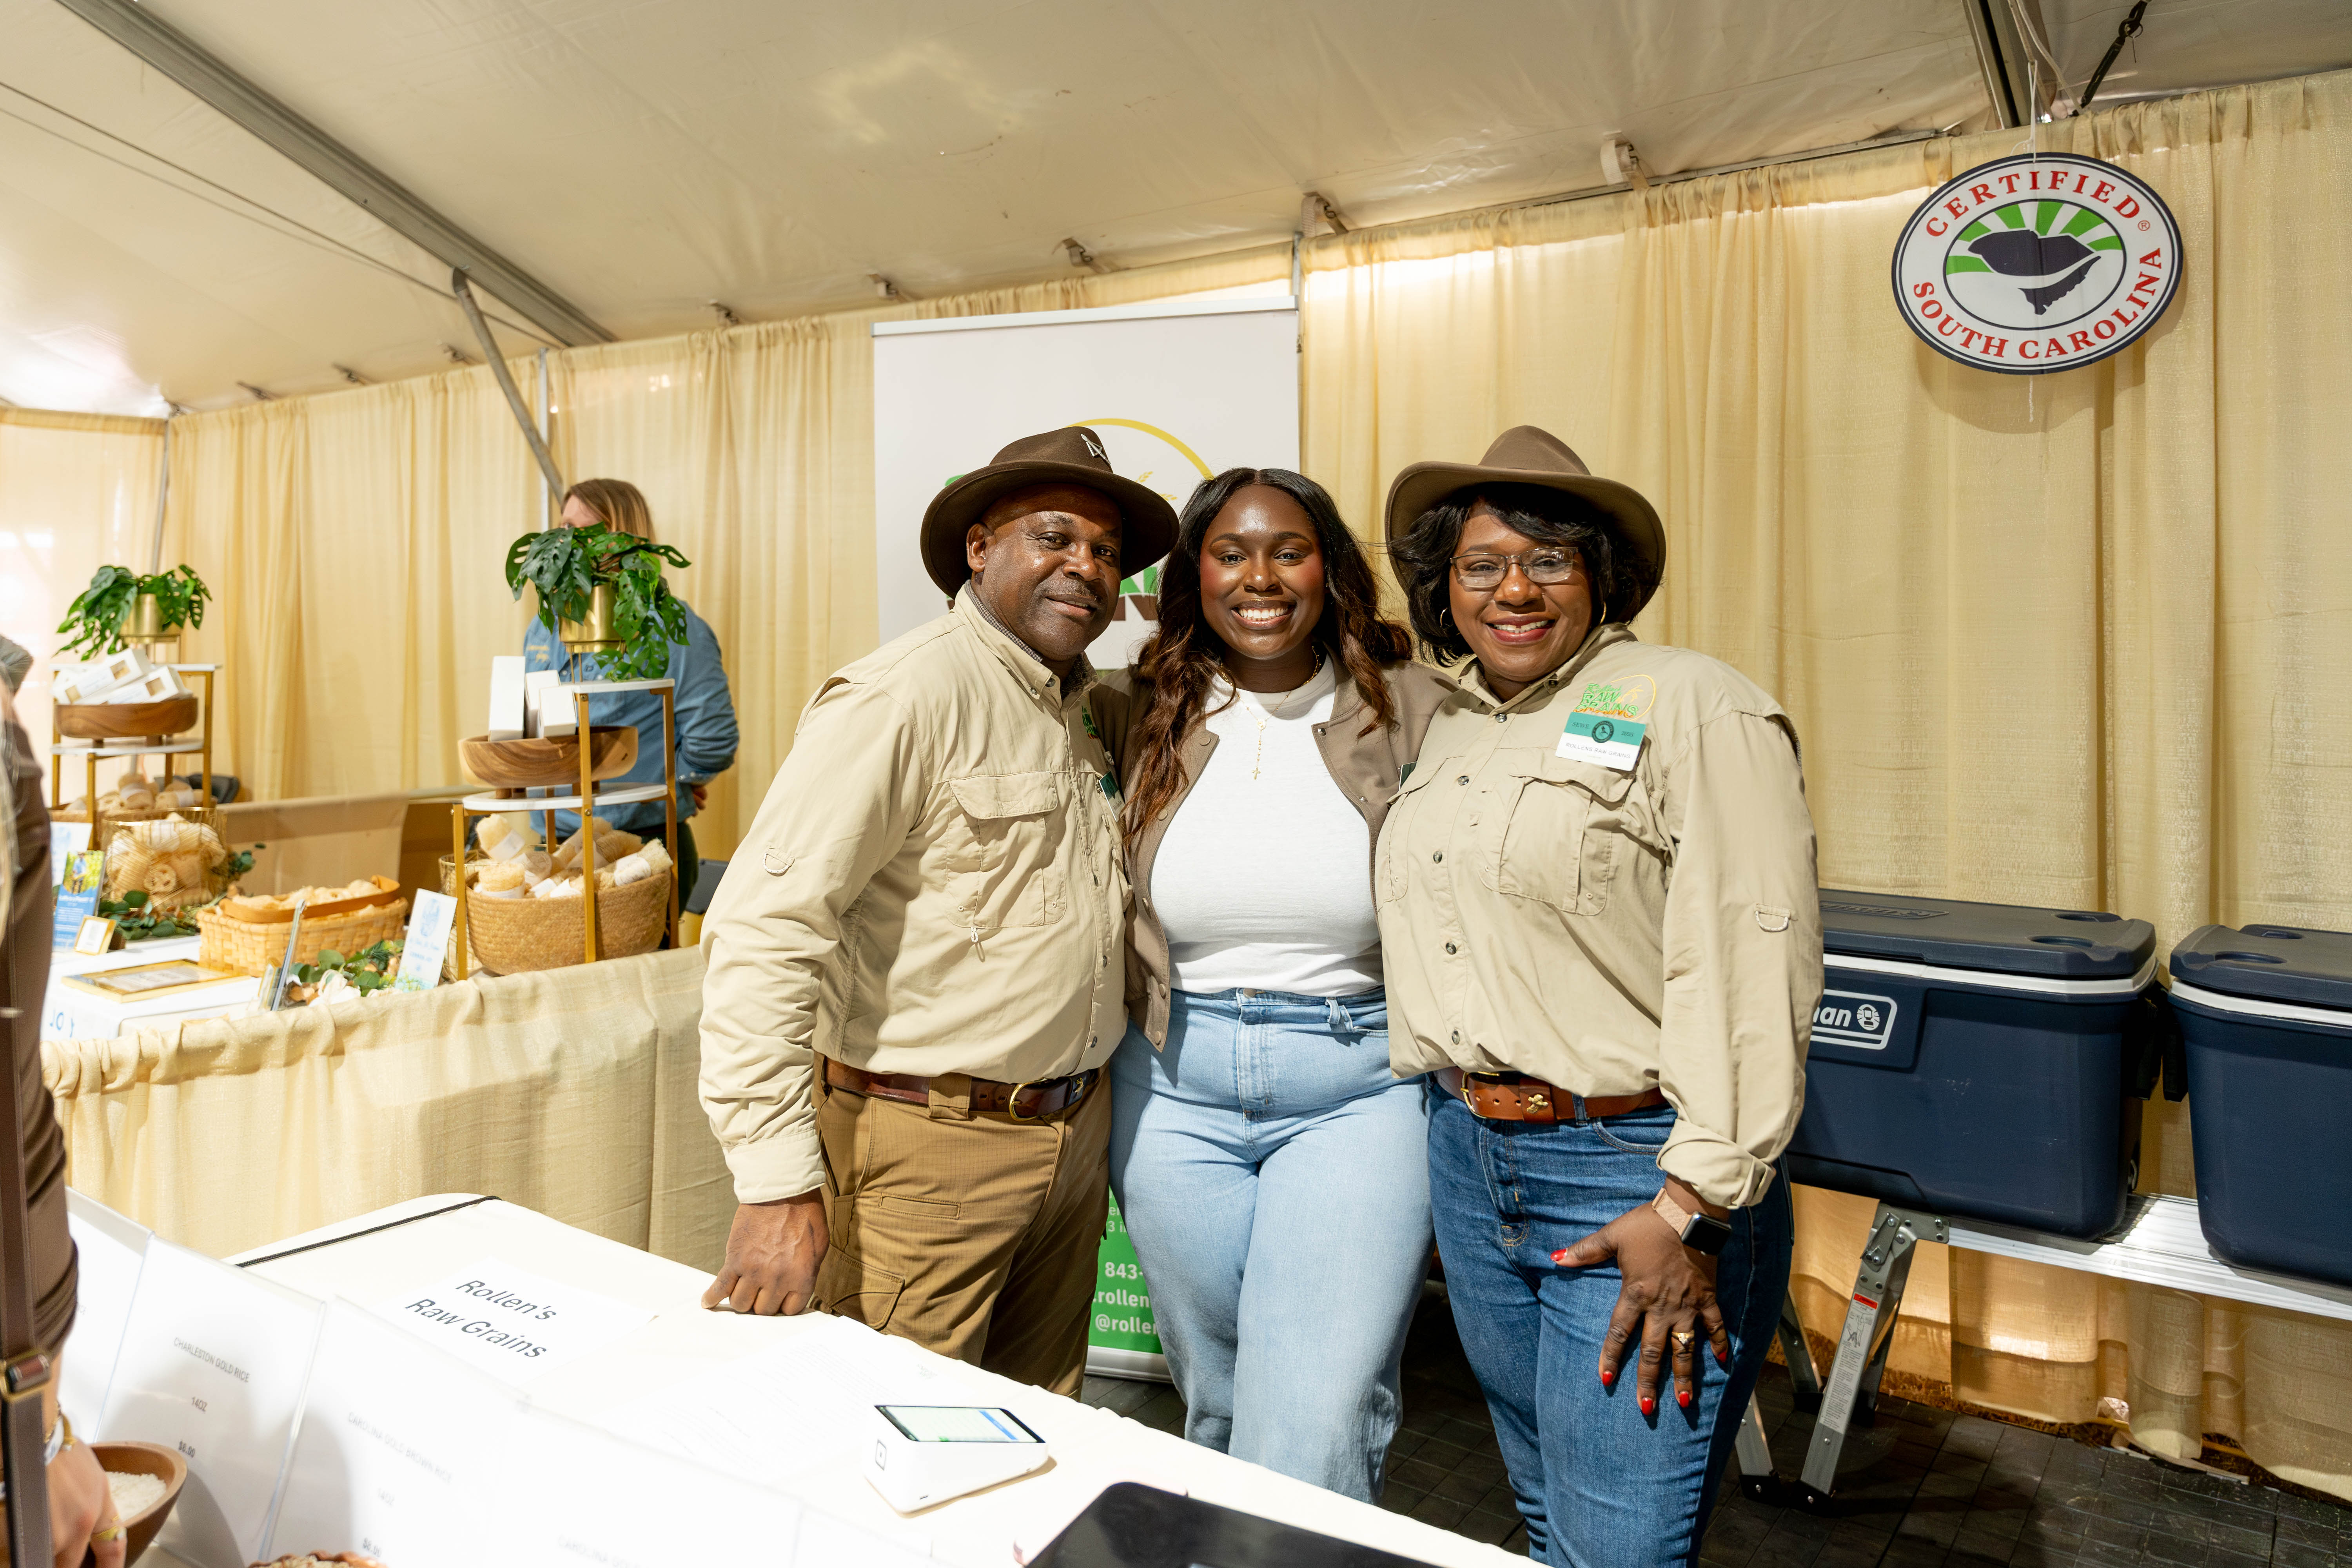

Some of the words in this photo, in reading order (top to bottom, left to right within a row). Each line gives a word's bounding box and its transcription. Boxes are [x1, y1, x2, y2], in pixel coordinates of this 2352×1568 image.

[1926, 171, 2140, 236] CERTIFIED
[1913, 281, 2009, 358] SOUTH
[2018, 248, 2162, 359] CAROLINA
[1580, 691, 1622, 704] RAW
[1565, 742, 1593, 751] ROLLENS
[455, 1280, 557, 1320] Rollen's
[405, 1298, 466, 1325] Raw
[461, 1321, 547, 1357] Grains
[174, 1337, 215, 1365] CHARLESTON
[216, 1358, 233, 1374] GOLD
[235, 1367, 250, 1382] RICE
[348, 1412, 383, 1439] CAROLINA
[406, 1447, 433, 1472] BROWN
